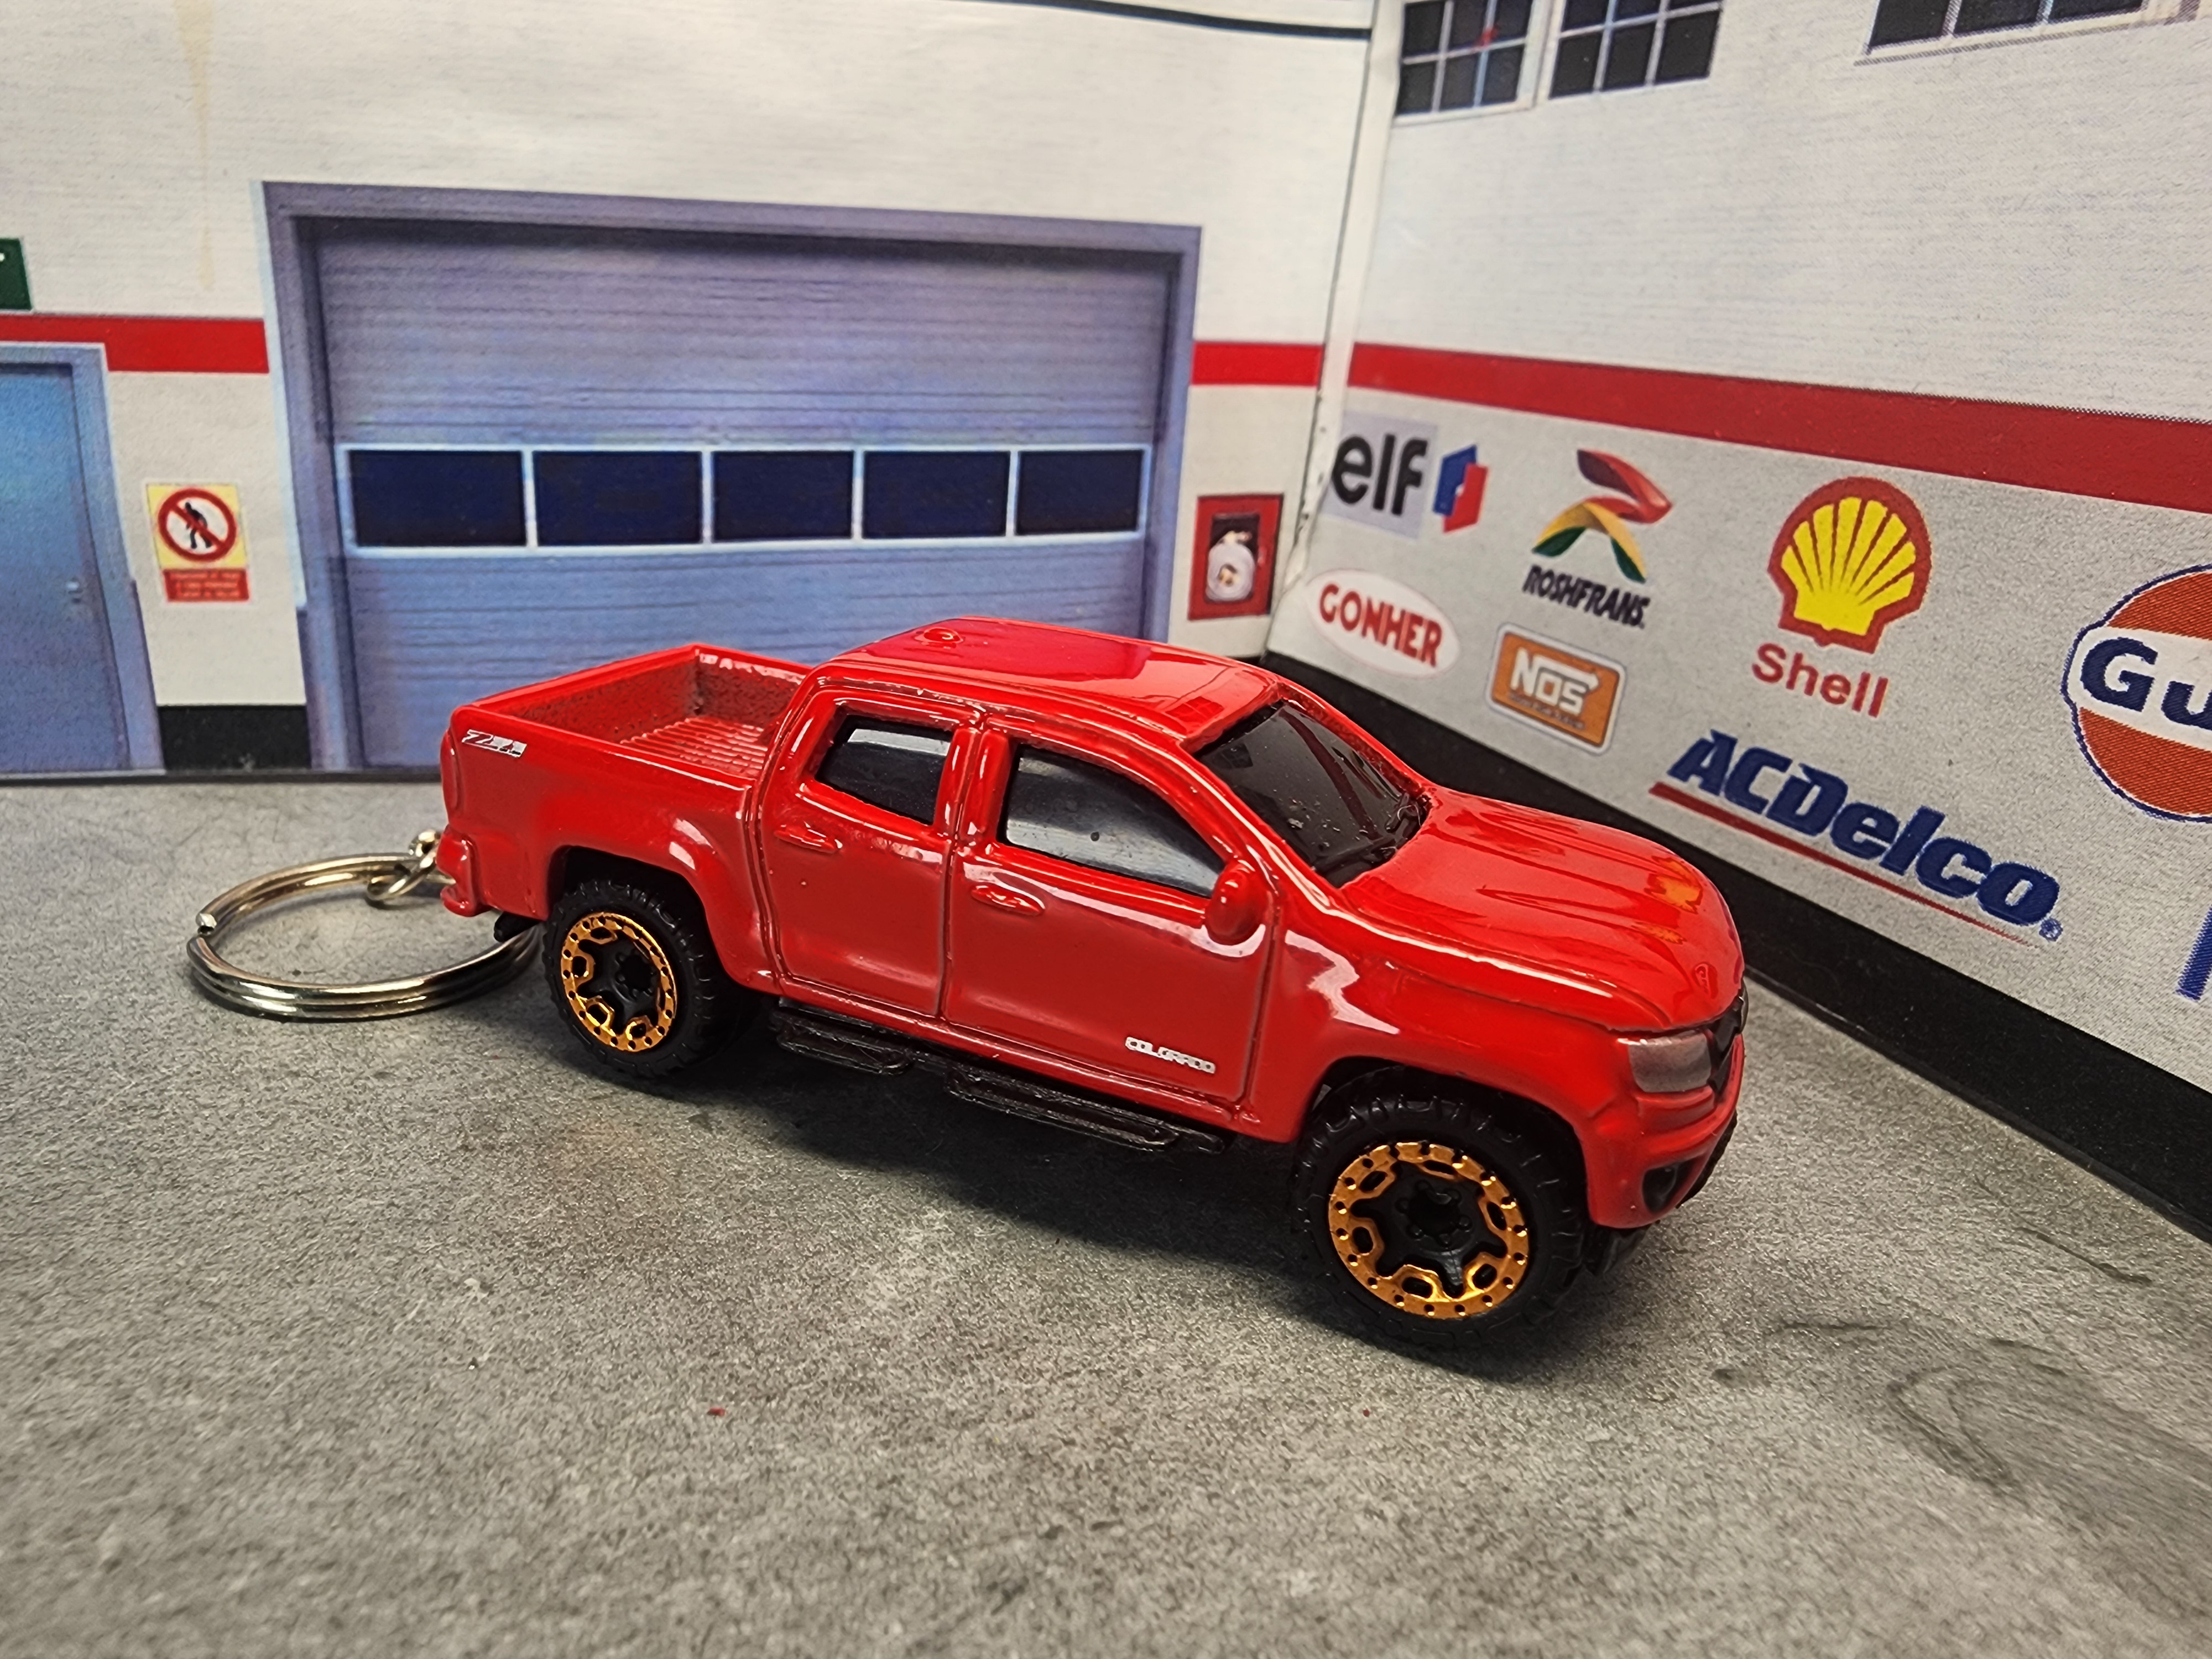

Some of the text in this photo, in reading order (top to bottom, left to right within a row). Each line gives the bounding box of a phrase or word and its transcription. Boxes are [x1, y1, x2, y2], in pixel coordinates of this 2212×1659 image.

[1332, 434, 1428, 515] elf
[1319, 584, 1442, 667] GONHER
[1510, 647, 1599, 717] NOS
[1751, 643, 1888, 718] Shell
[1666, 728, 2060, 926] ACDelco
